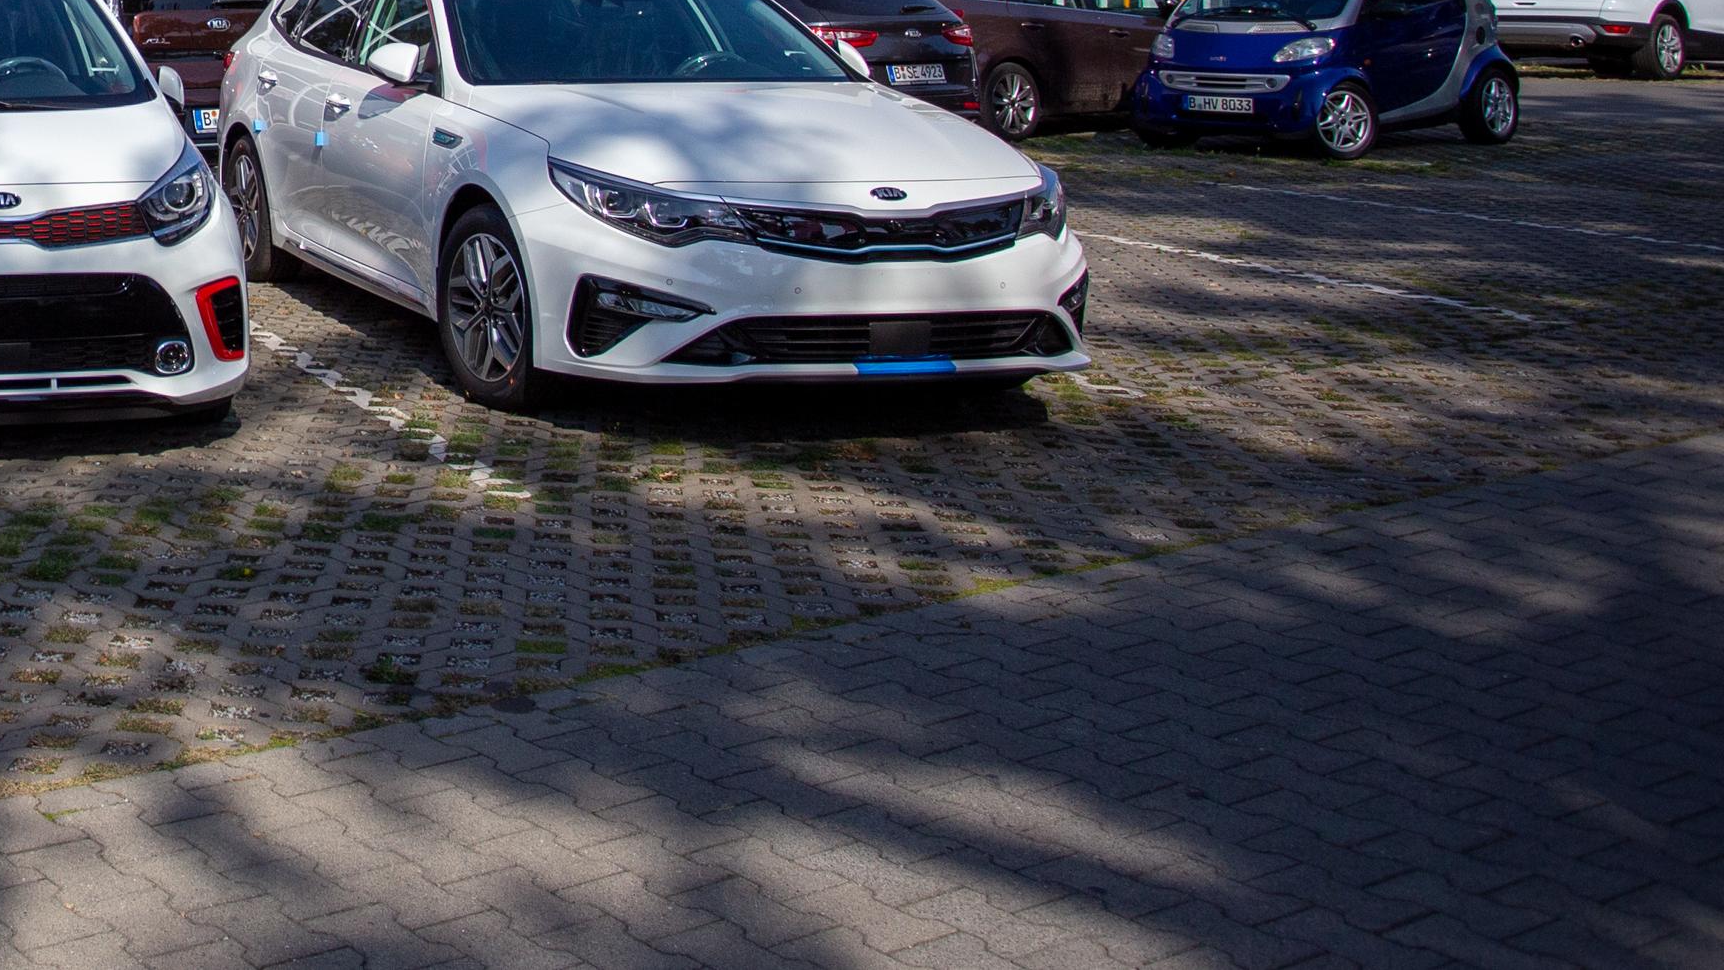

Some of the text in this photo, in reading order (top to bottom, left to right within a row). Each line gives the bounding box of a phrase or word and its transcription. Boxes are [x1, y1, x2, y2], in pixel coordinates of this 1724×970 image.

[895, 68, 901, 79] B
[1189, 96, 1252, 111] B HV 8033
[203, 113, 211, 126] B
[875, 188, 903, 198] KIA
